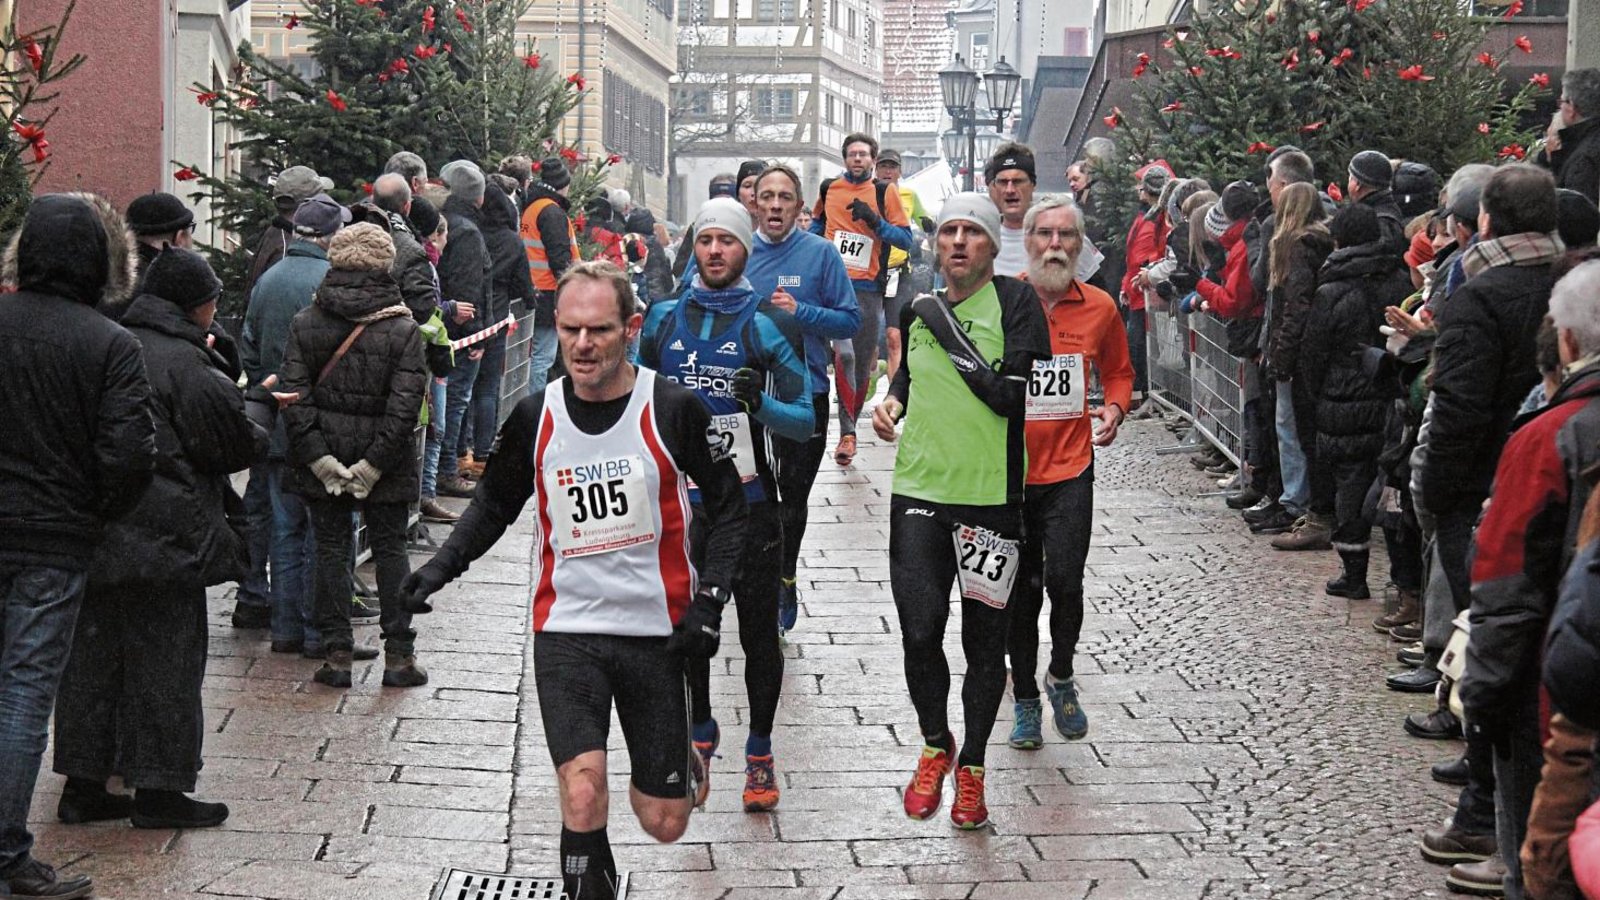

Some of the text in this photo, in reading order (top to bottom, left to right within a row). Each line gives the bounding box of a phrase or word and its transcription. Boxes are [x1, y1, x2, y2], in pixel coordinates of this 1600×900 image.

[840, 239, 865, 257] 647
[1028, 369, 1071, 397] 628
[568, 479, 628, 523] 305
[904, 508, 936, 518] 2XU
[583, 523, 637, 538] Kreissparkasse
[584, 532, 632, 546] Ludwigsburg
[960, 543, 1007, 581] 213
